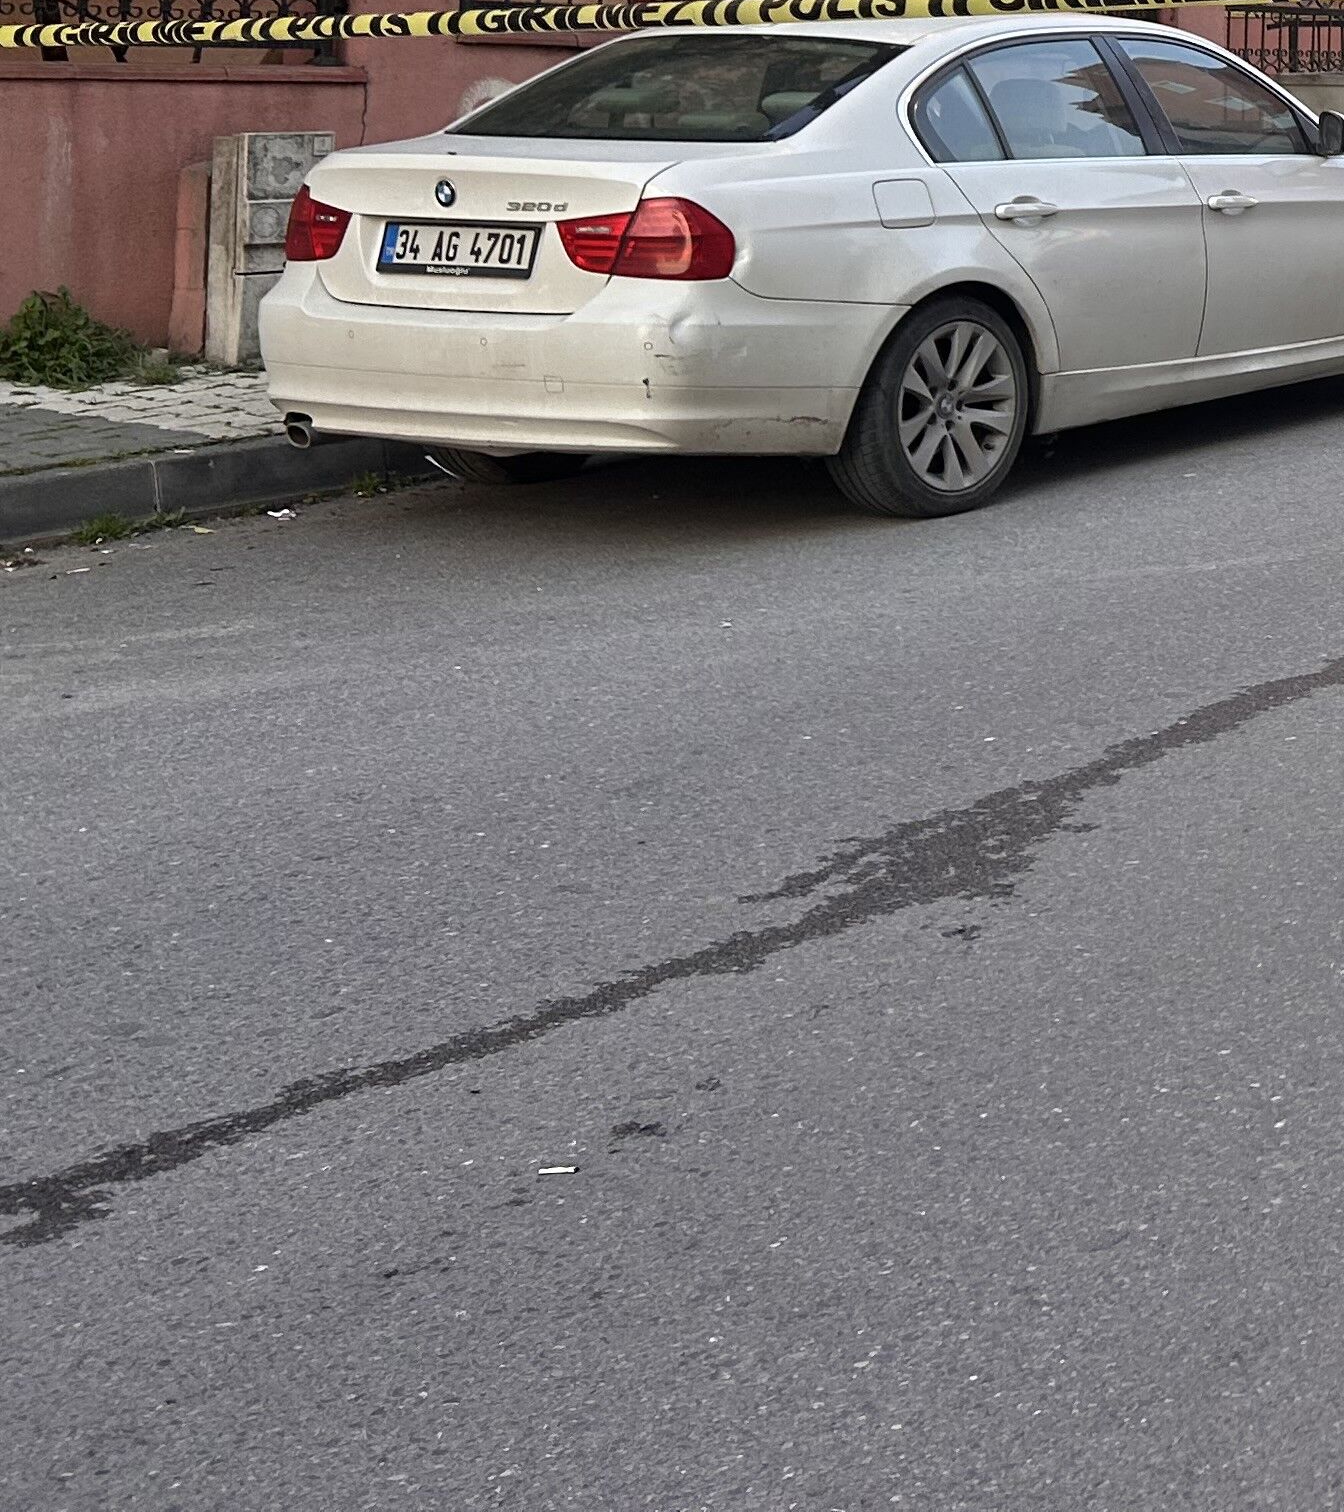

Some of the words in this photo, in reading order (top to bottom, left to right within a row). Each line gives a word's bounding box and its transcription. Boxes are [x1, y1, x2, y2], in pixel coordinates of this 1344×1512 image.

[506, 201, 569, 212] 320d
[395, 229, 420, 260] 34
[431, 230, 461, 262] AG
[469, 232, 527, 266] 4701
